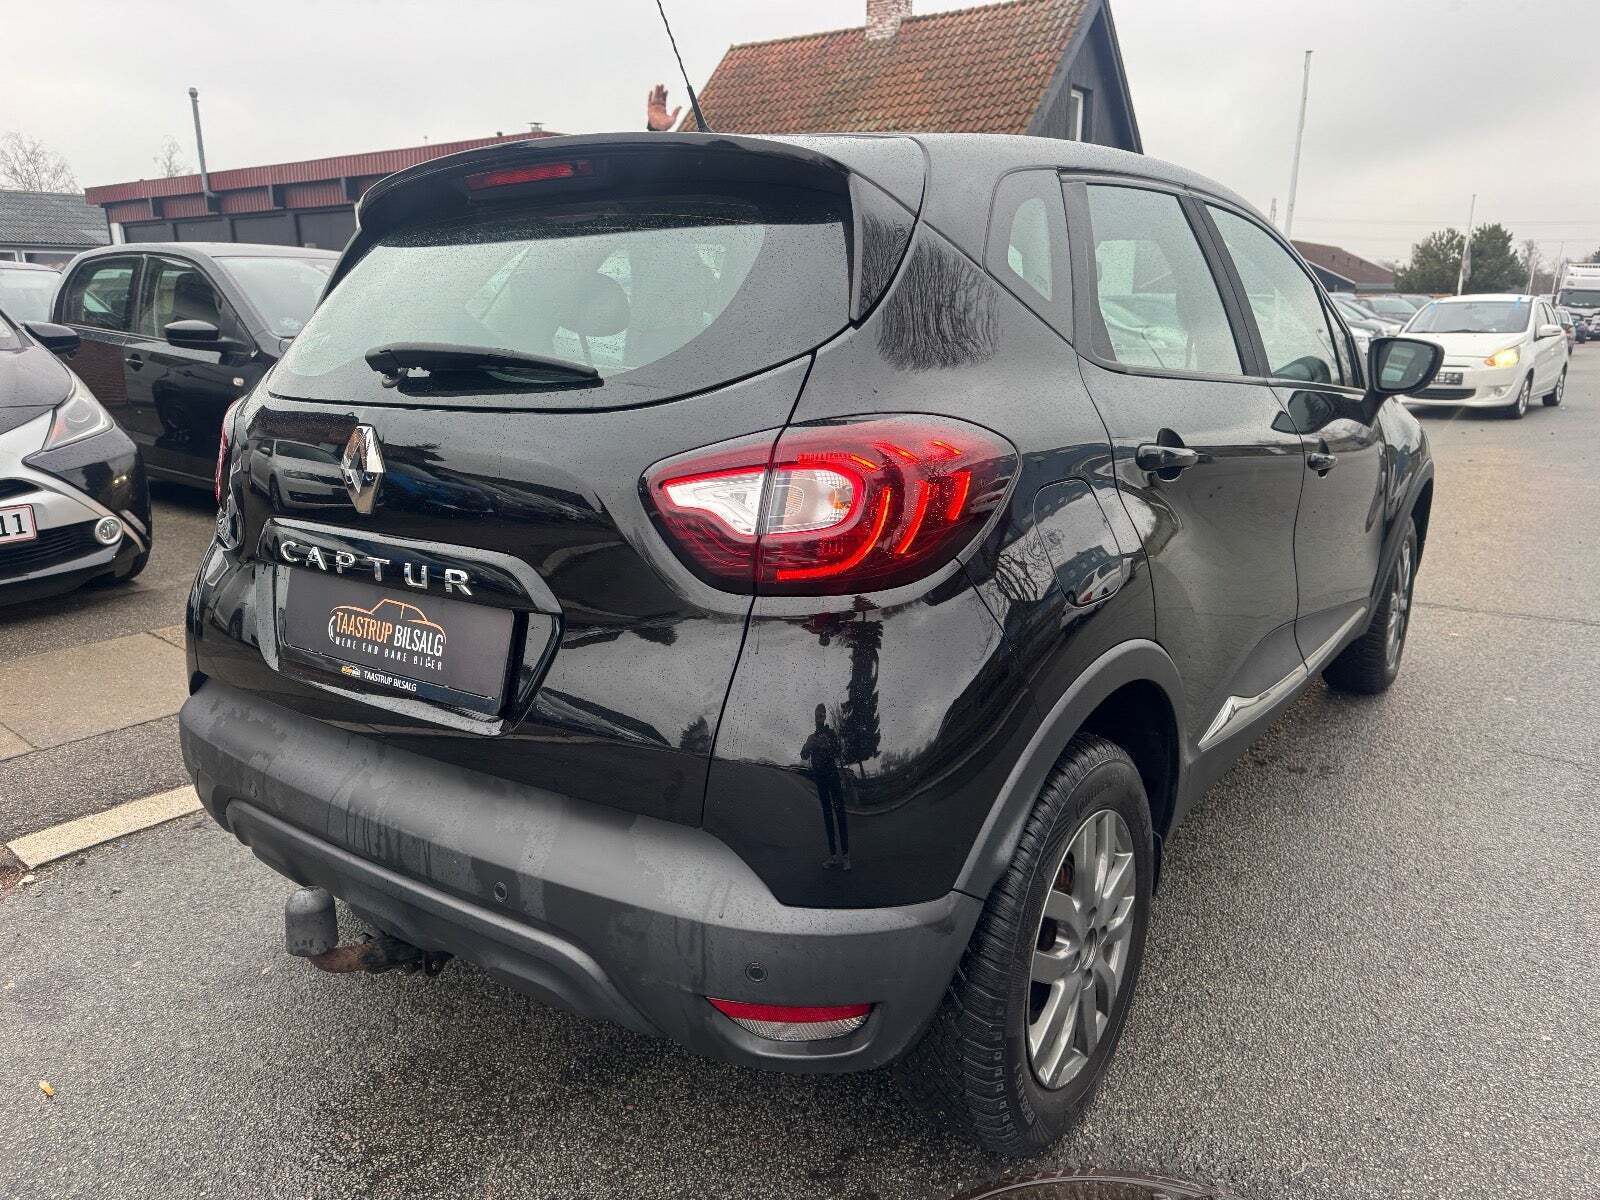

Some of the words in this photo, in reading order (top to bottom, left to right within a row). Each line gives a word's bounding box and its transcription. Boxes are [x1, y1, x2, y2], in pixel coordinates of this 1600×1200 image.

[280, 540, 473, 596] CAPTUR
[336, 611, 393, 643] TAASTRUP
[394, 624, 443, 657] BILSALG
[364, 670, 393, 686] TAASTRUP
[393, 678, 417, 692] BILSALG
